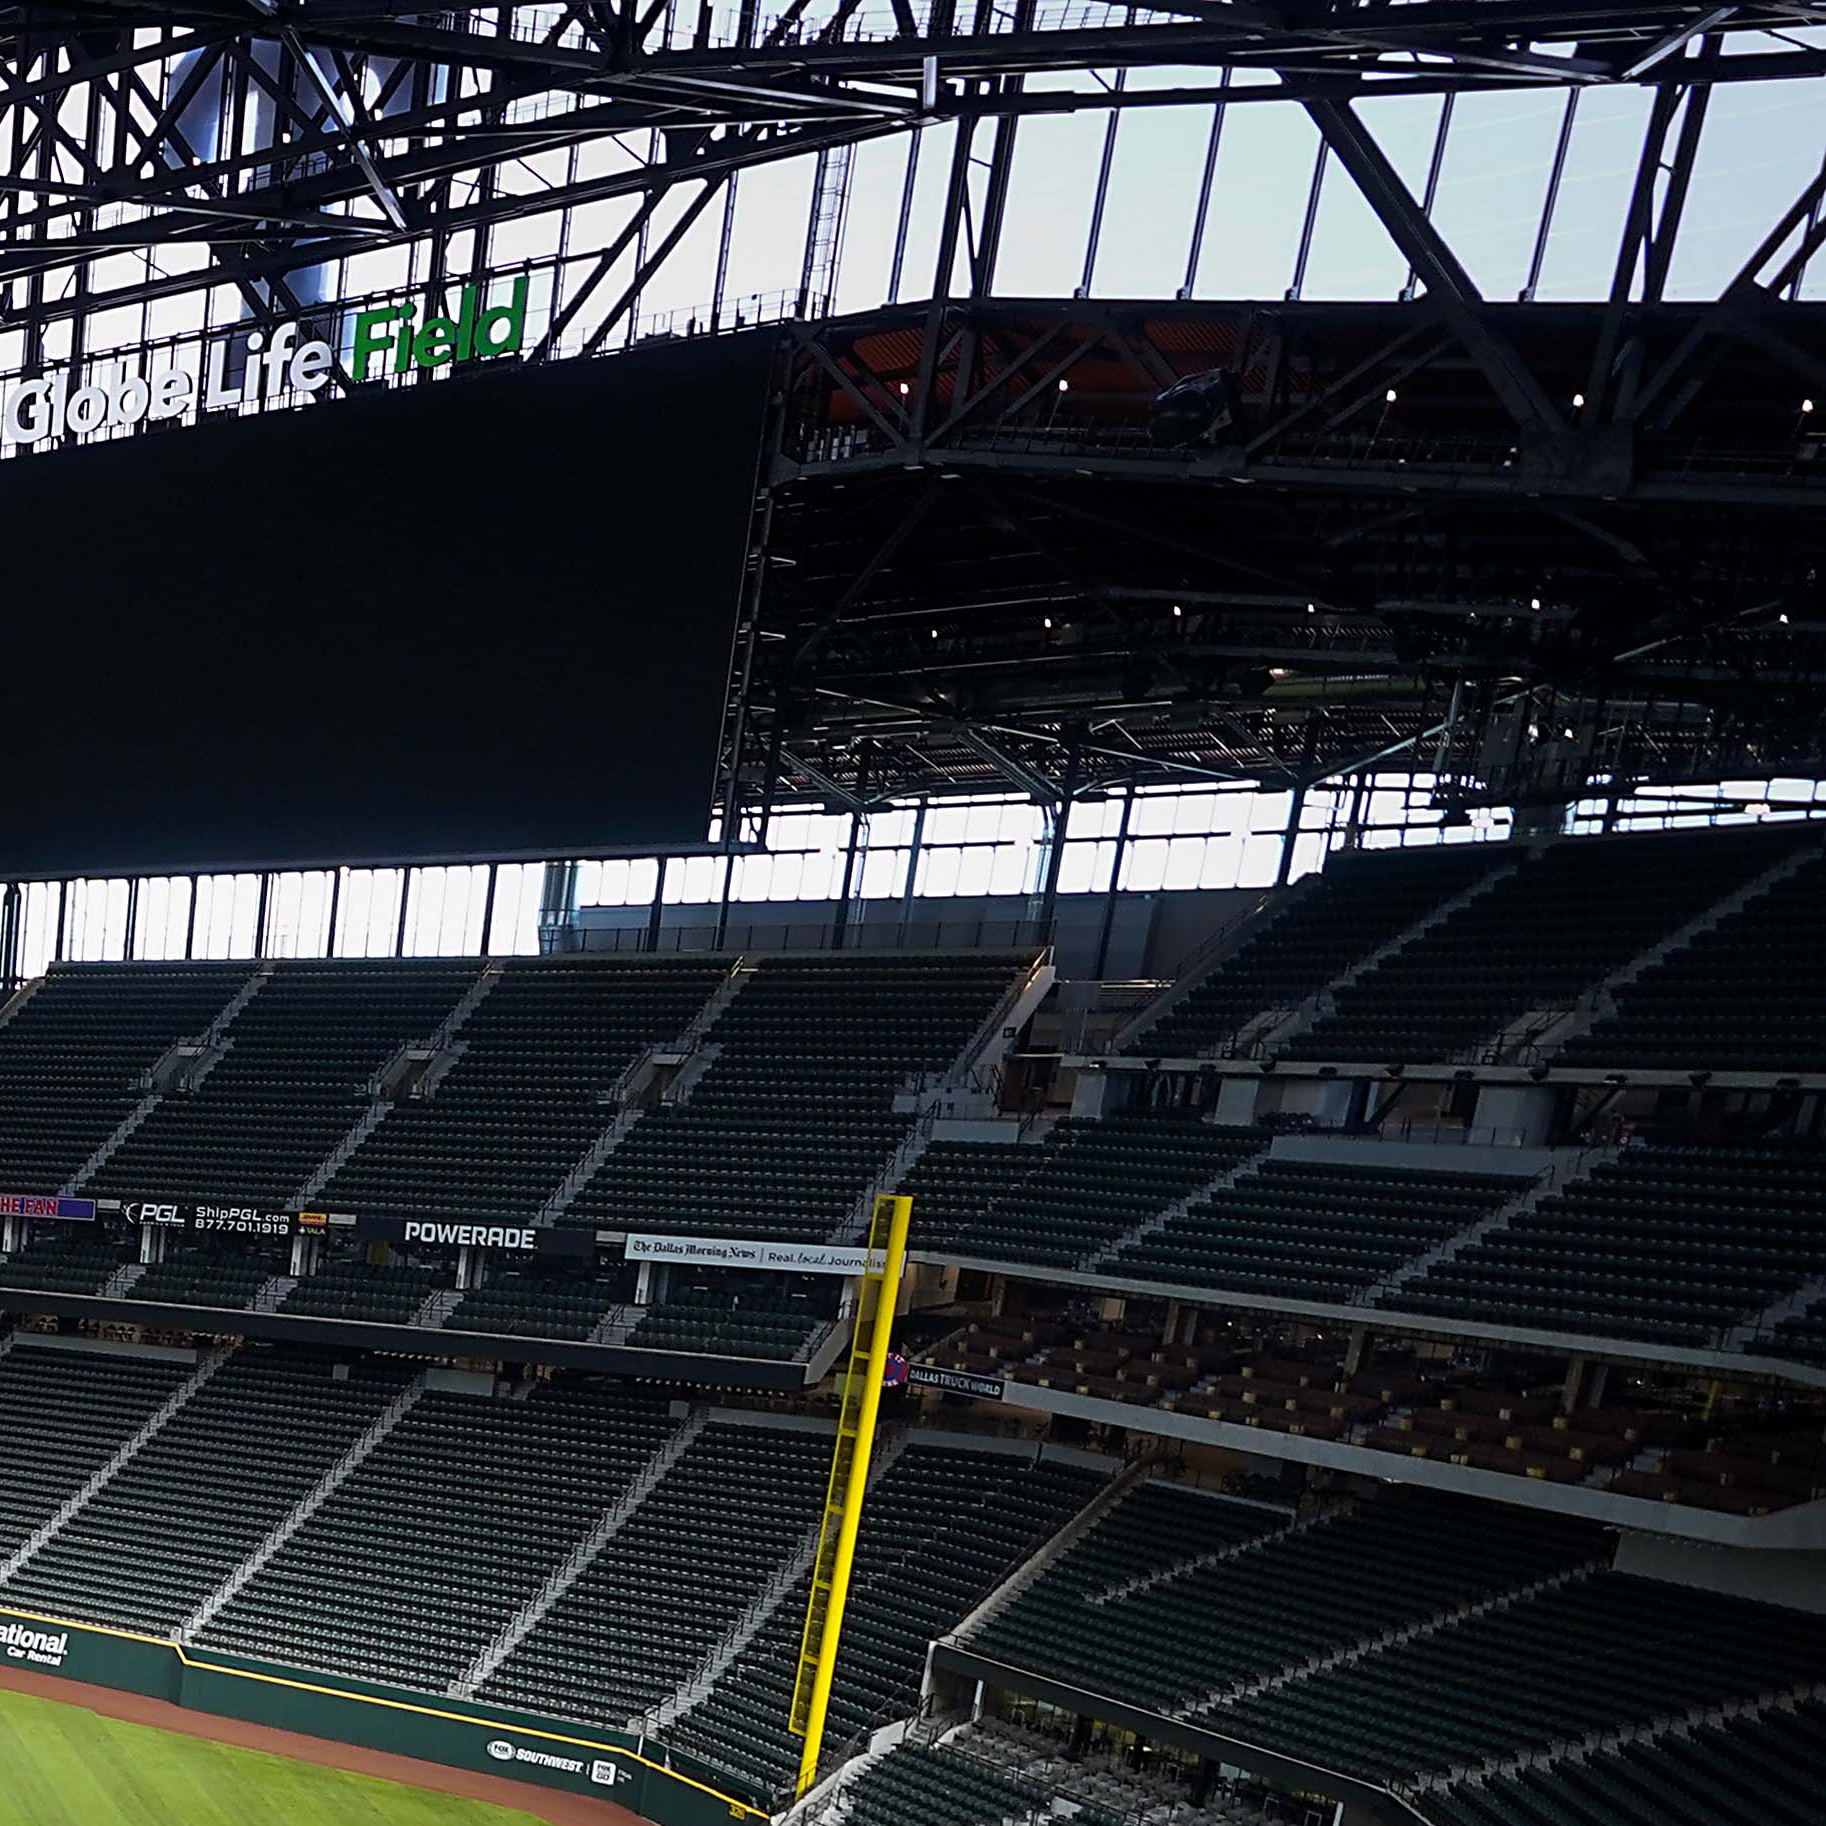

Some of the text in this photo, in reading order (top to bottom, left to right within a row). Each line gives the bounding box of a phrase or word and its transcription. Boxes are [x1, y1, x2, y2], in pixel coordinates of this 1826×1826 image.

[4, 275, 528, 445] Globe Life Field
[24, 1198, 59, 1216] FAN
[140, 1203, 185, 1223] PGL
[196, 1206, 290, 1224] ShipPGL.com
[194, 1218, 289, 1235] 877.701.1919
[405, 1222, 535, 1250] POWERADE
[633, 1240, 756, 1260] The Dallas Morning News
[910, 1368, 939, 1384] DALLAS
[940, 1373, 969, 1390] TRUCK
[970, 1379, 1001, 1397] WORLD
[7, 1646, 62, 1666] Car Rental
[516, 1749, 584, 1773] SOUTHWEST
